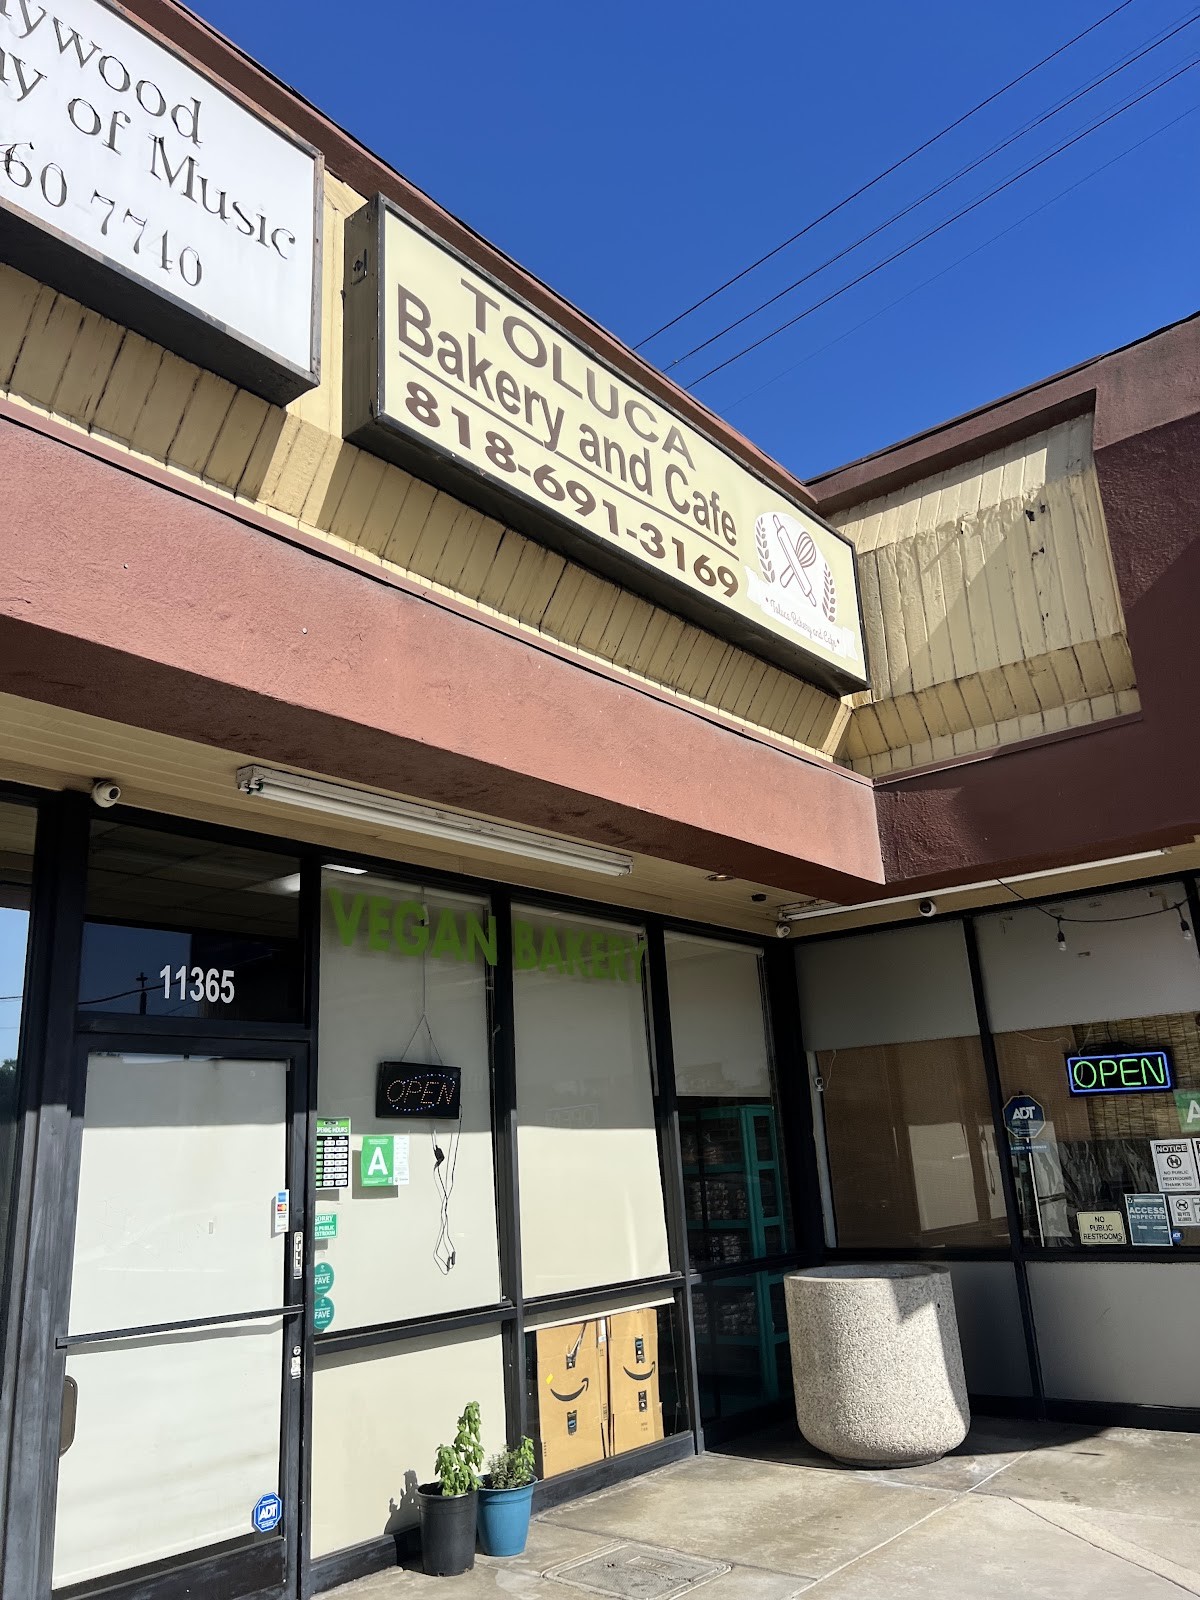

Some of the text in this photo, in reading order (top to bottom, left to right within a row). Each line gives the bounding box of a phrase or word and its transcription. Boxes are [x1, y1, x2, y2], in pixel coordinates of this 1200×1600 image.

[68, 98, 131, 155] of
[148, 132, 296, 260] Music
[461, 278, 696, 472] TOLUCA
[397, 283, 738, 547] Bakery and Cafe
[404, 380, 739, 598] 818-691-3169
[326, 887, 648, 983] VEGAN BAKERY
[160, 964, 235, 1004] 11365
[1073, 1056, 1165, 1088] OPEN
[386, 1080, 456, 1105] OPEN
[1012, 1106, 1036, 1120] ADT
[367, 1146, 388, 1176] A
[1156, 1144, 1187, 1153] NOTICE
[1129, 1206, 1165, 1214] ACCESS
[1083, 1232, 1123, 1240] RESTROOMS
[1089, 1224, 1114, 1232] PUBLIC
[315, 1275, 331, 1285] FAVE
[314, 1310, 331, 1319] FAVE
[259, 1503, 278, 1521] ADT
